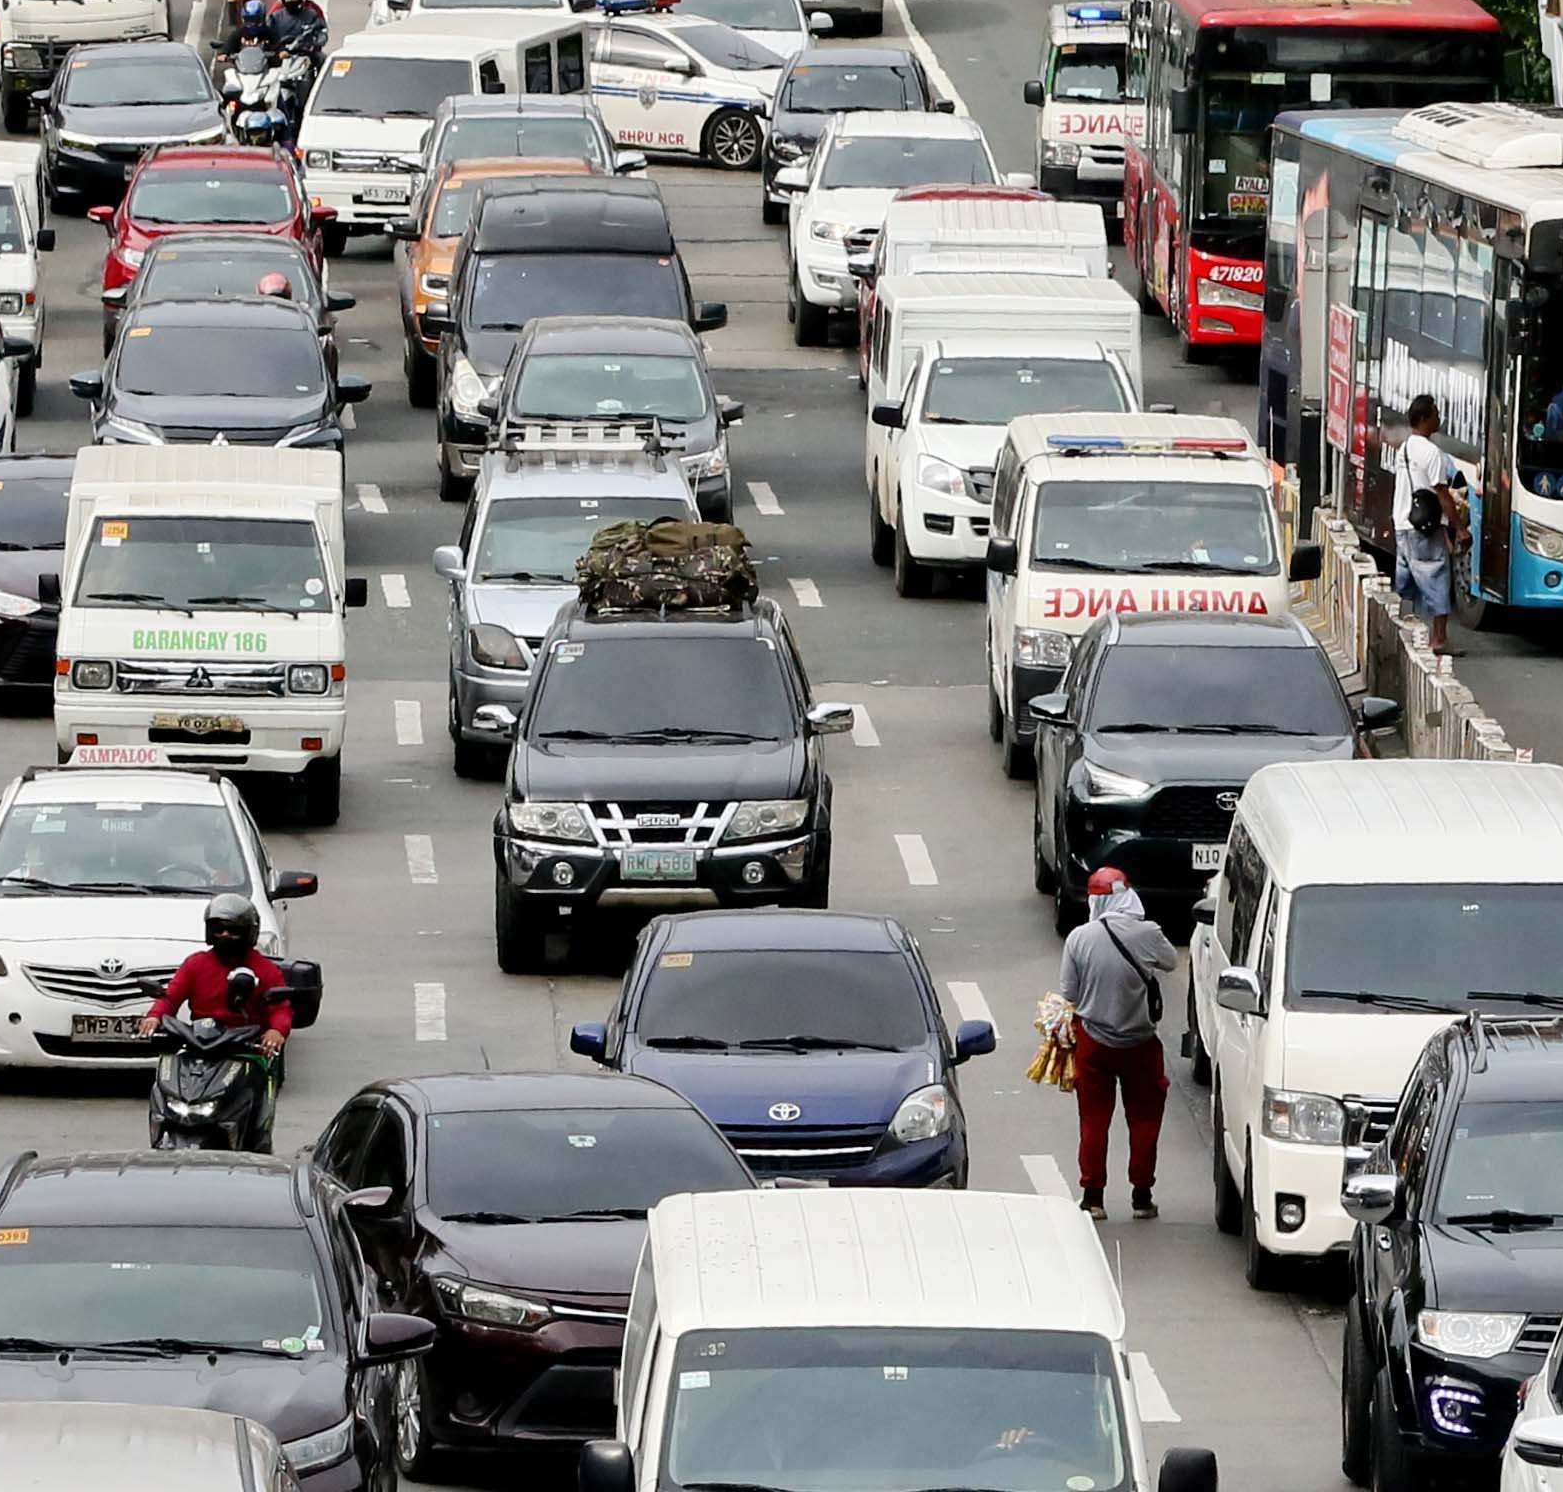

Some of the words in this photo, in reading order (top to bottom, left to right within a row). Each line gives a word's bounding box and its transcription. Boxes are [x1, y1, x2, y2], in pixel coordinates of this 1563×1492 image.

[618, 130, 654, 143] RHPU
[658, 132, 685, 145] NCR
[1236, 177, 1269, 191] AYALA
[1209, 266, 1264, 282] 471820
[133, 628, 229, 652] BARANGAY
[233, 631, 268, 653] 186
[79, 748, 157, 763] SAMPALOC
[637, 815, 679, 826] ISUZU
[662, 854, 692, 870] 586
